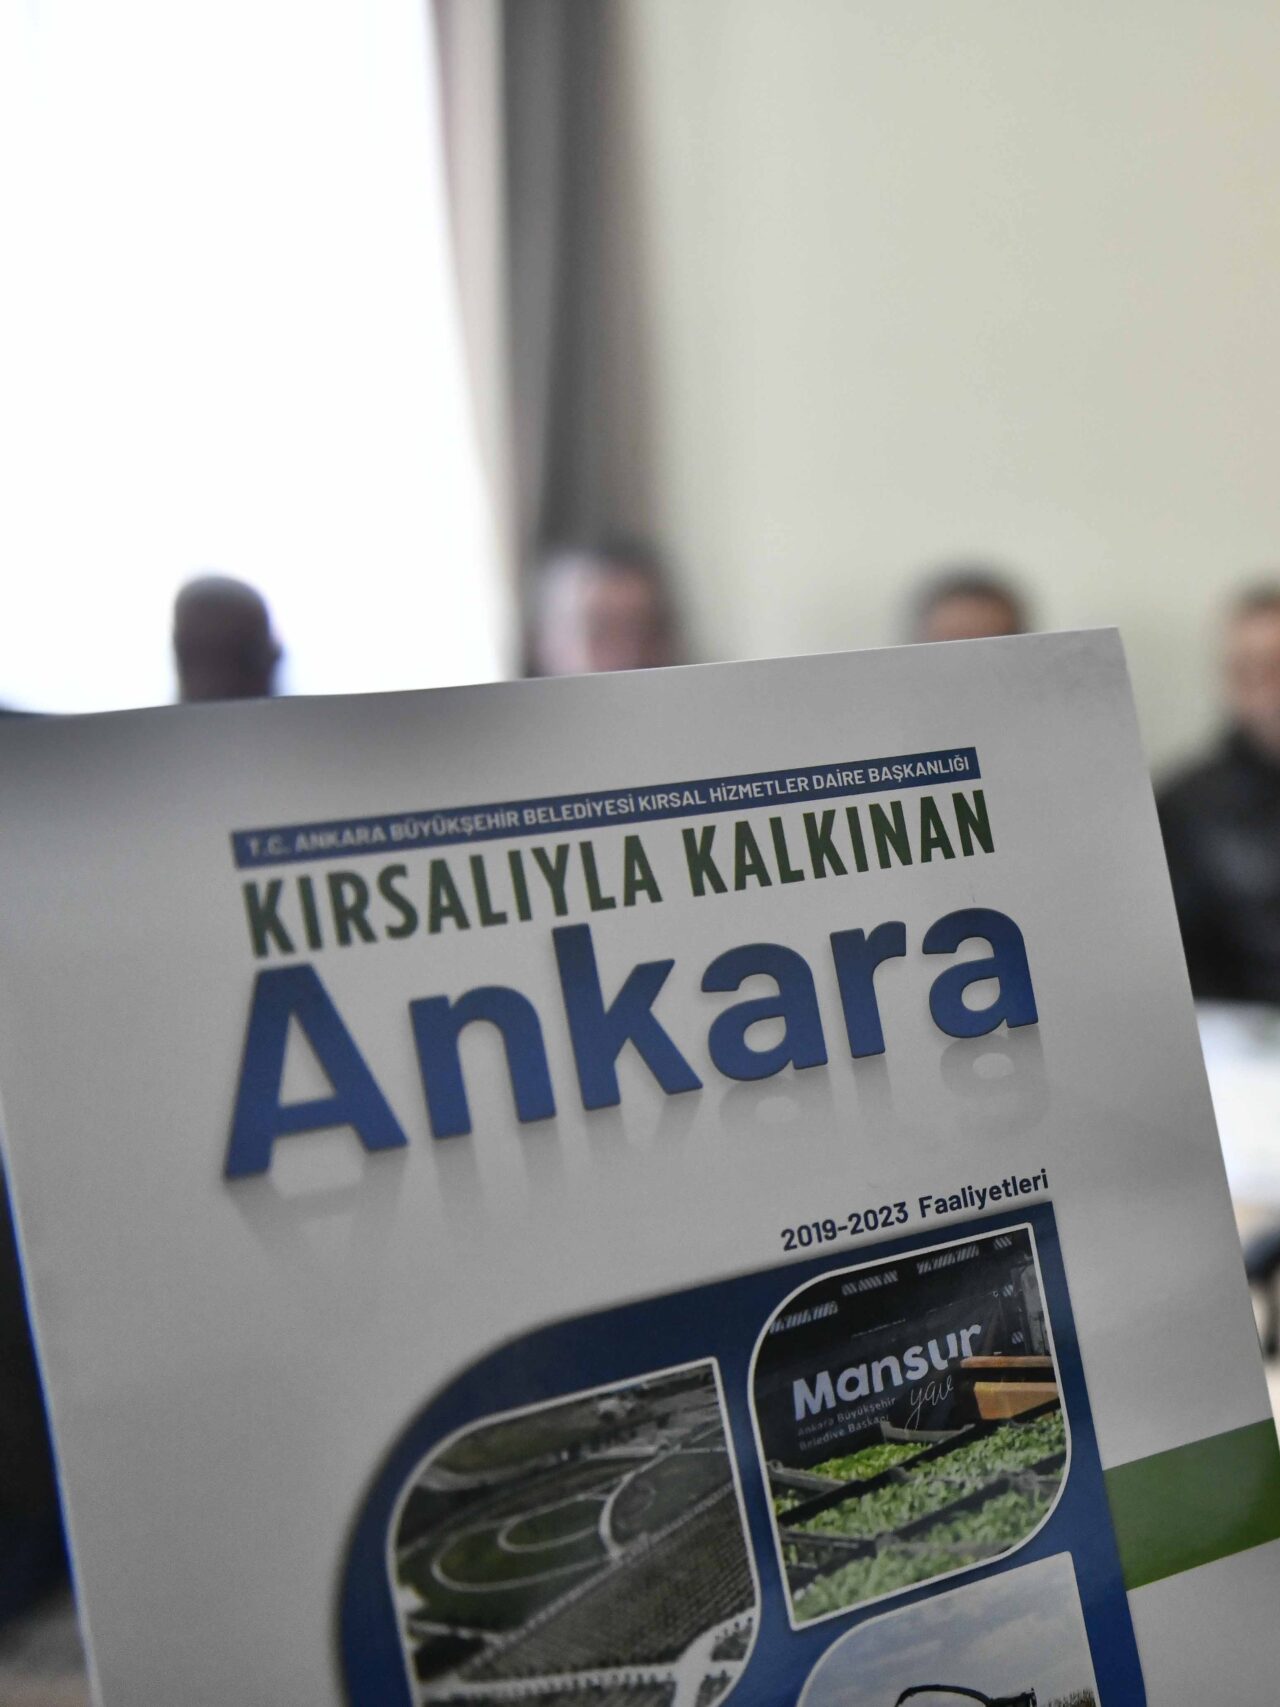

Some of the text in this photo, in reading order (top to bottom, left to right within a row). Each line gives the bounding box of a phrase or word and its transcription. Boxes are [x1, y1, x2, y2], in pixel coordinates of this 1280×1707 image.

[247, 754, 970, 856] T.C. ANKARA BÜYÜKŞEHİR BELEDİYESİ KIRSAL HİZMETLER DAİRE BAŞKANLIĞI
[243, 789, 995, 959] KIRSALIYLA KALKINAN
[223, 906, 1039, 1180] Ankara
[779, 1168, 1049, 1252] 2019-2023 Faaliyetleri
[792, 1323, 982, 1422] Mansur
